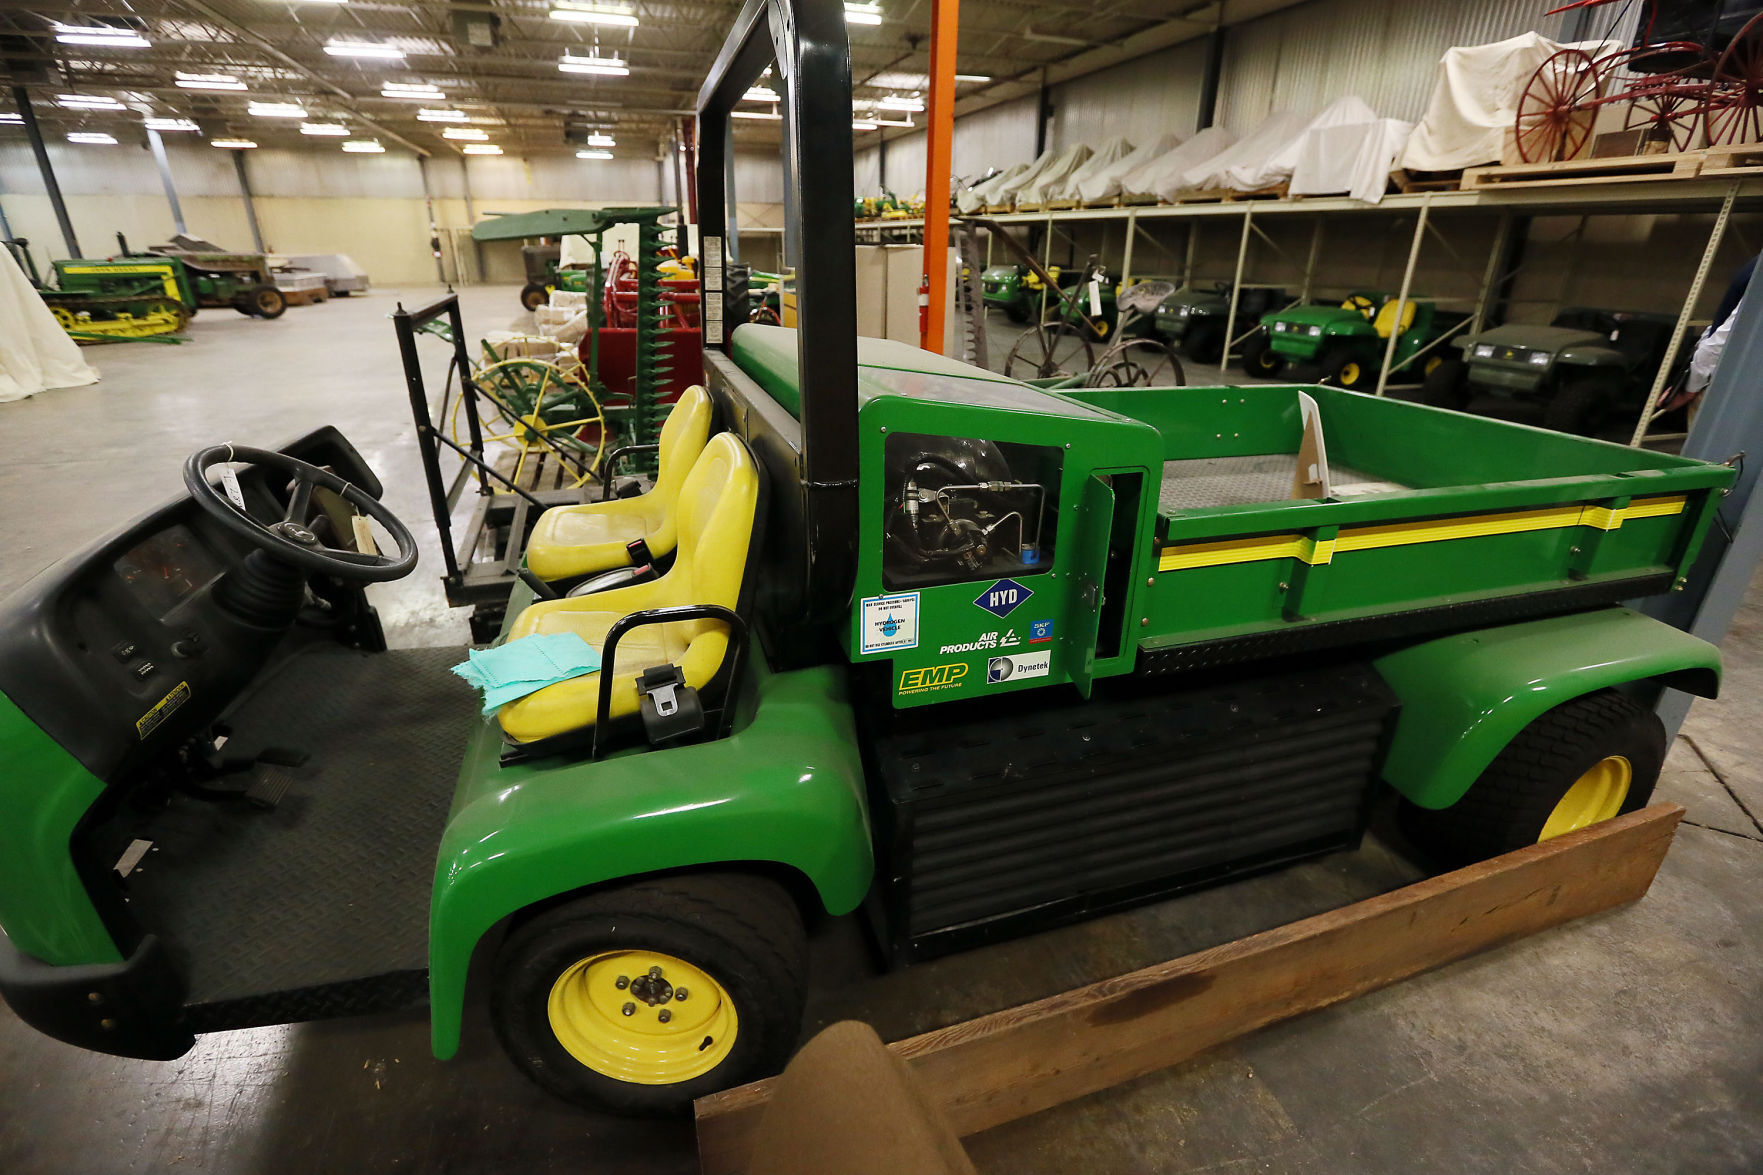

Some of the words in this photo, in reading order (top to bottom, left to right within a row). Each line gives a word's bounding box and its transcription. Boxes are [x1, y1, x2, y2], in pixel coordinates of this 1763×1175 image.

[990, 588, 1018, 608] HYD
[979, 632, 998, 642] AIR
[940, 640, 997, 654] PRODUCTS
[1018, 662, 1048, 673] Dynetek
[899, 662, 968, 690] EMP
